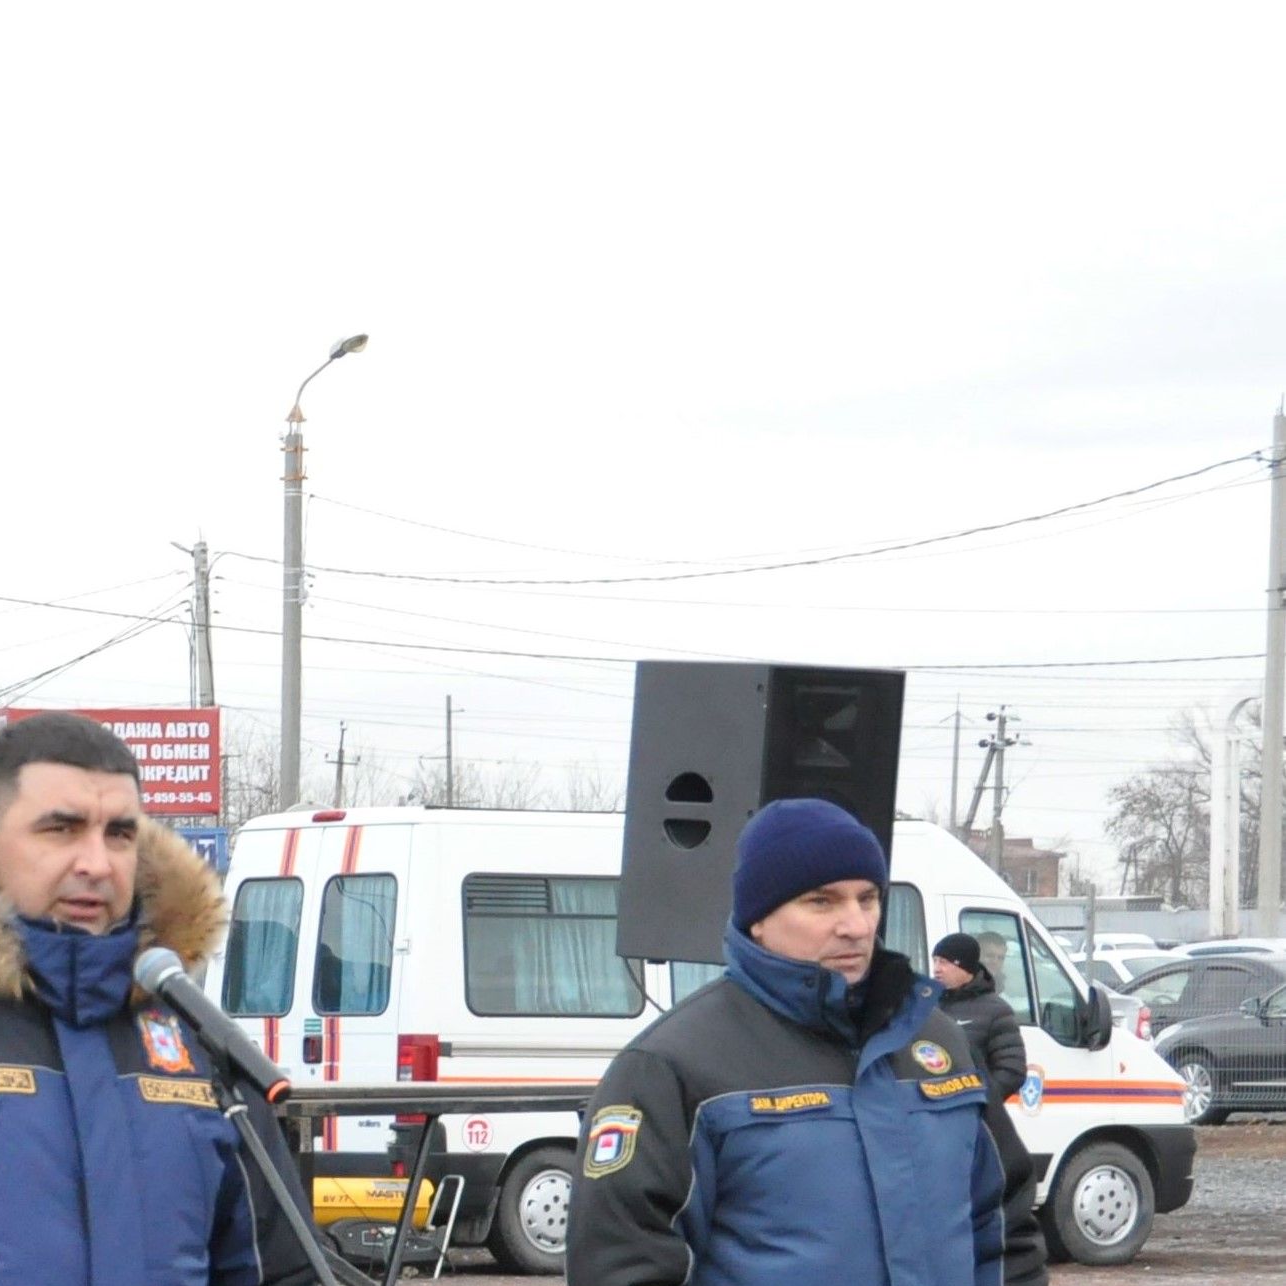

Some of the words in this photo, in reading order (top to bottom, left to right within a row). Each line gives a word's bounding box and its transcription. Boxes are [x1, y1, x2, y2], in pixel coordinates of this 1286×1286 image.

[101, 722, 160, 740] ДАЖА
[165, 722, 210, 738] АВТО
[151, 744, 210, 760] ОБМЕН
[467, 1130, 488, 1145] 112
